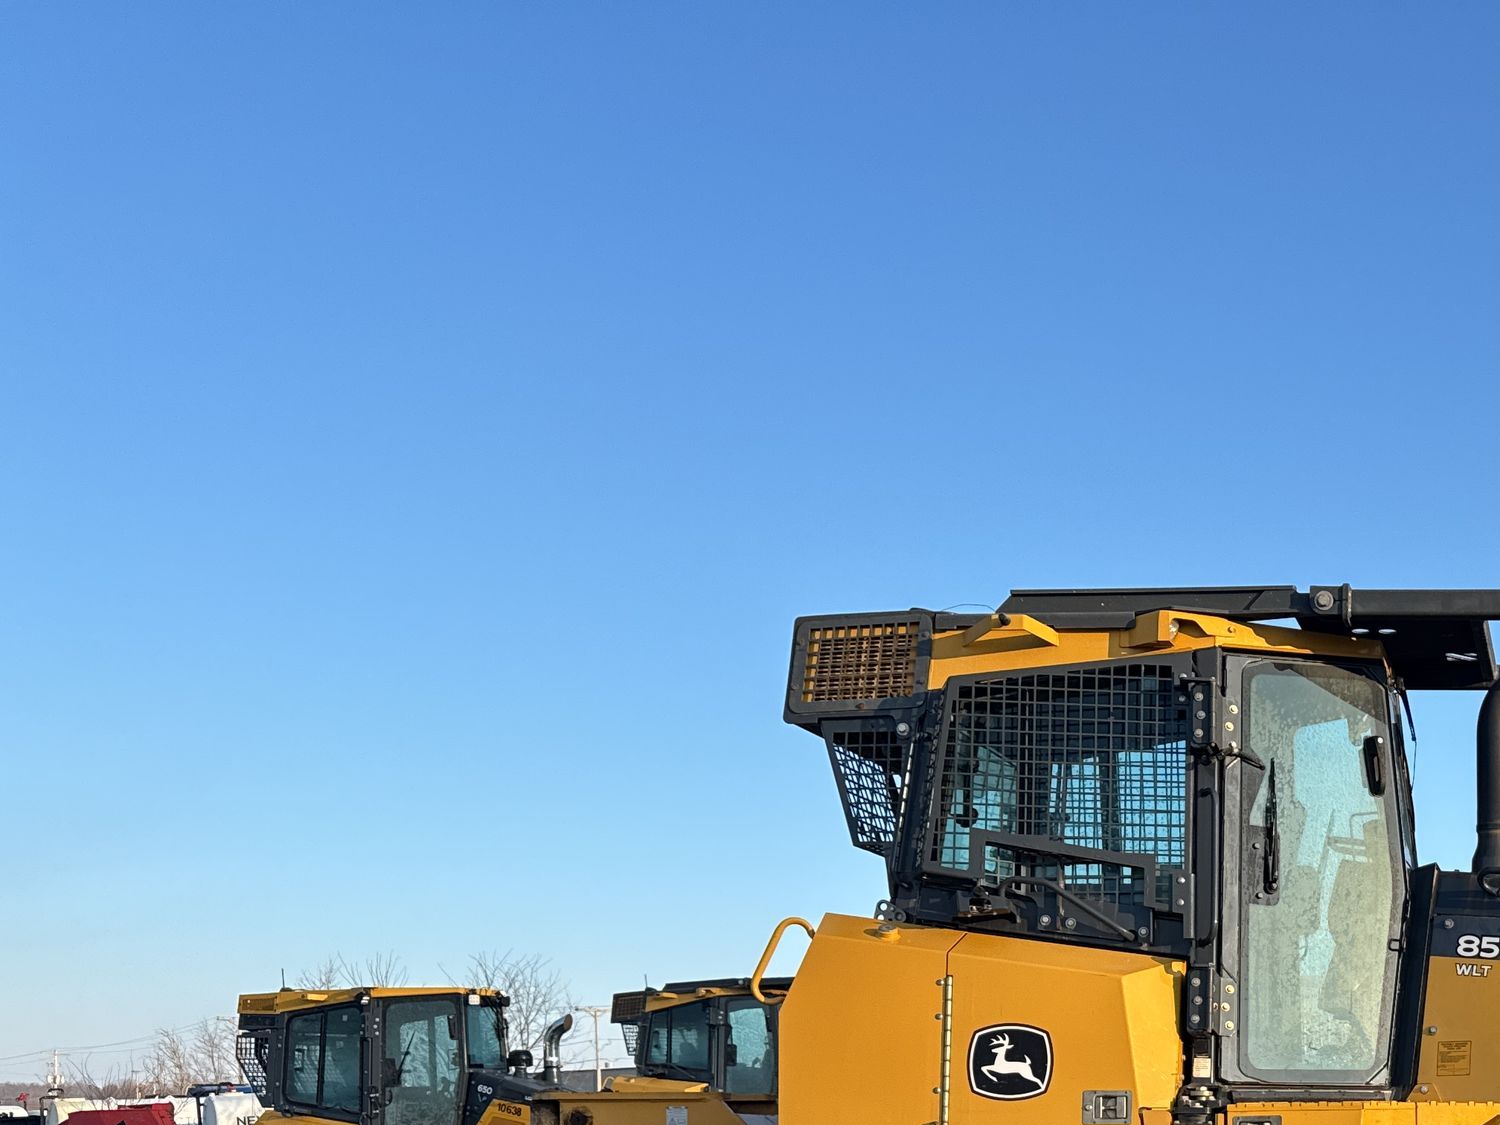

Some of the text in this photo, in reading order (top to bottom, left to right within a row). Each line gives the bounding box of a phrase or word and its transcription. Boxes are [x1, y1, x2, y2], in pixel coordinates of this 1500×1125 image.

[1455, 963, 1492, 977] WLT
[477, 1084, 493, 1095] 650
[497, 1102, 522, 1117] 10638
